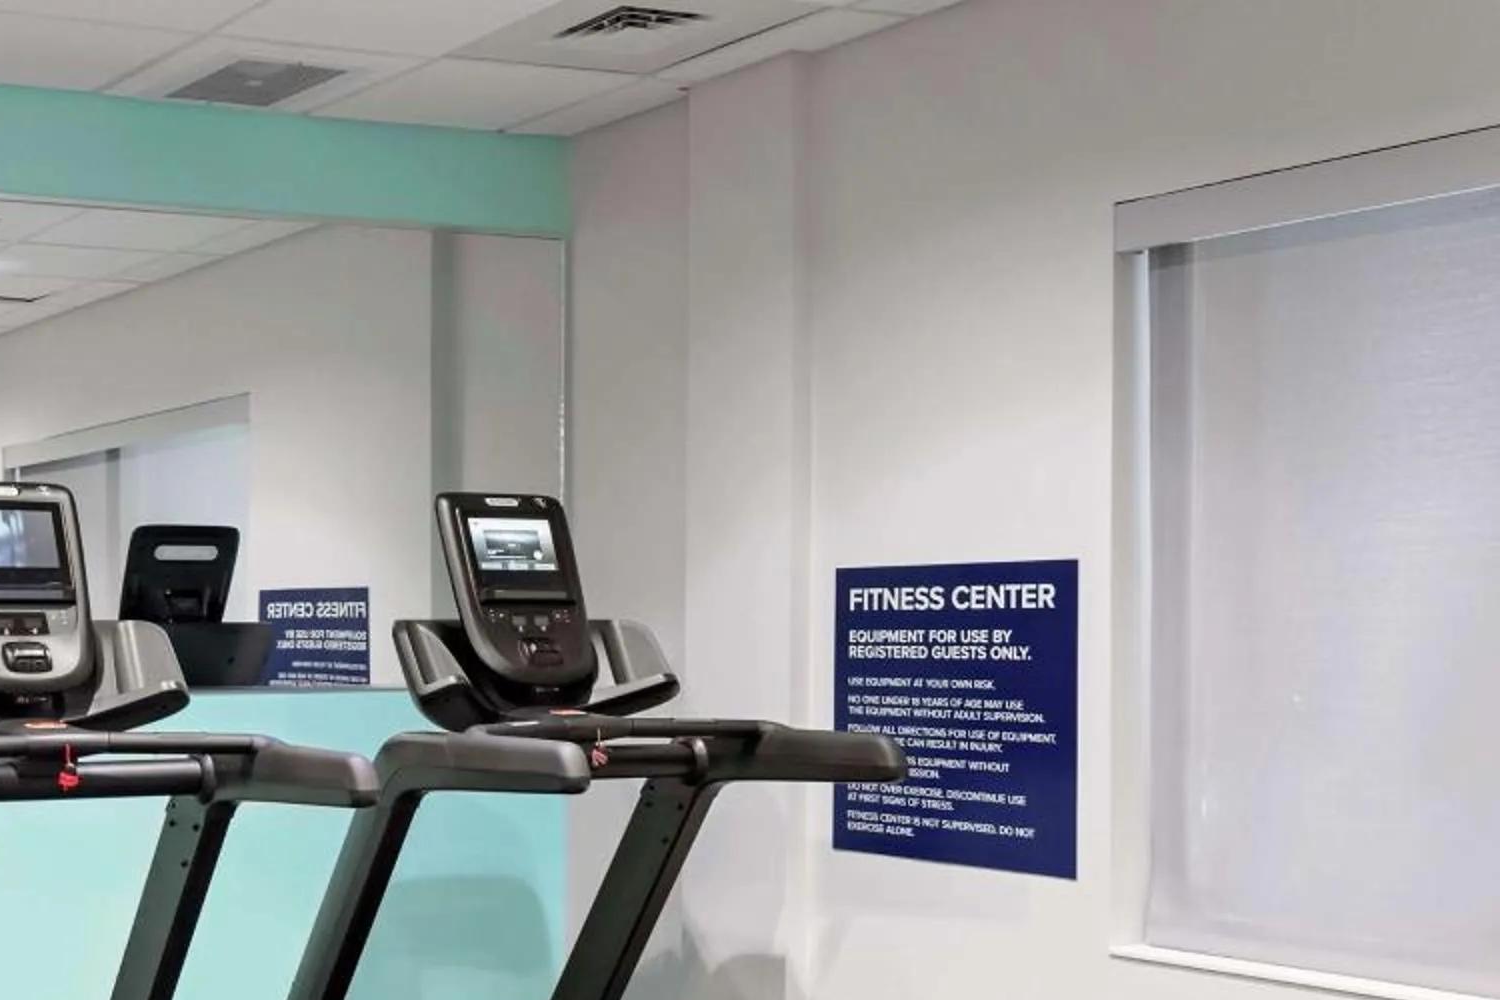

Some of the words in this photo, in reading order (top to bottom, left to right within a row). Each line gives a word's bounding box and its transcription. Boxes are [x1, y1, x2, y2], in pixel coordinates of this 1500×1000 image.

[849, 586, 945, 611] FITNESS
[951, 583, 1056, 610] CENTER
[848, 629, 925, 643] EQUIPMENT
[929, 629, 957, 643] FOR
[960, 629, 989, 643] USE
[992, 629, 1013, 643] BY
[848, 645, 929, 659] REGISTERED
[931, 645, 987, 660] GUESTS
[989, 645, 1032, 661] ONLY.
[847, 676, 863, 687] USE
[865, 677, 911, 688] EQUIPMENT
[913, 678, 923, 688] AT
[925, 679, 949, 689] YOUR
[950, 679, 973, 689] OWN
[974, 680, 996, 690] RISK.
[847, 694, 861, 705] NO
[862, 695, 880, 705] ONE
[882, 695, 910, 706] UNDER
[921, 697, 948, 707] YEARS
[950, 698, 962, 708] OF
[964, 699, 982, 709] AGE
[984, 700, 1003, 710] MAY
[1005, 700, 1025, 711] USE
[848, 705, 864, 716] THE
[866, 706, 911, 717] EQUIPMENT
[913, 708, 952, 719] WITHOUT
[953, 709, 982, 720] ADULT
[983, 711, 1046, 723] SUPERVISION.
[847, 723, 881, 733] FOLLOW
[882, 725, 897, 735] ALL
[898, 726, 947, 738] DIRECTIONS
[948, 729, 966, 739] FOR
[967, 730, 986, 740] USE
[987, 731, 1000, 741] OF
[907, 738, 925, 748] CAN
[926, 739, 957, 750] RESULT
[959, 741, 969, 751] IN
[970, 742, 1003, 753] INJURY.
[918, 757, 967, 769] EQUIPMENT
[968, 761, 1010, 773] WITHOUT
[847, 791, 858, 801] AT
[859, 792, 880, 803] FIRST
[882, 794, 906, 807] SIGNS
[907, 798, 920, 808] OF
[920, 798, 955, 811] STRESS.
[880, 784, 902, 794] OVER
[946, 789, 1007, 804] DISCONTINUE
[1008, 795, 1027, 806] USE
[847, 809, 879, 821] FITNESS
[880, 812, 912, 825] CENTER
[922, 817, 940, 829] NOT
[941, 819, 998, 835] SUPERVISED.
[999, 825, 1014, 837] DO
[1015, 827, 1036, 840] NOT
[847, 820, 884, 834] EXERCISE
[885, 825, 916, 838] ALONE.
